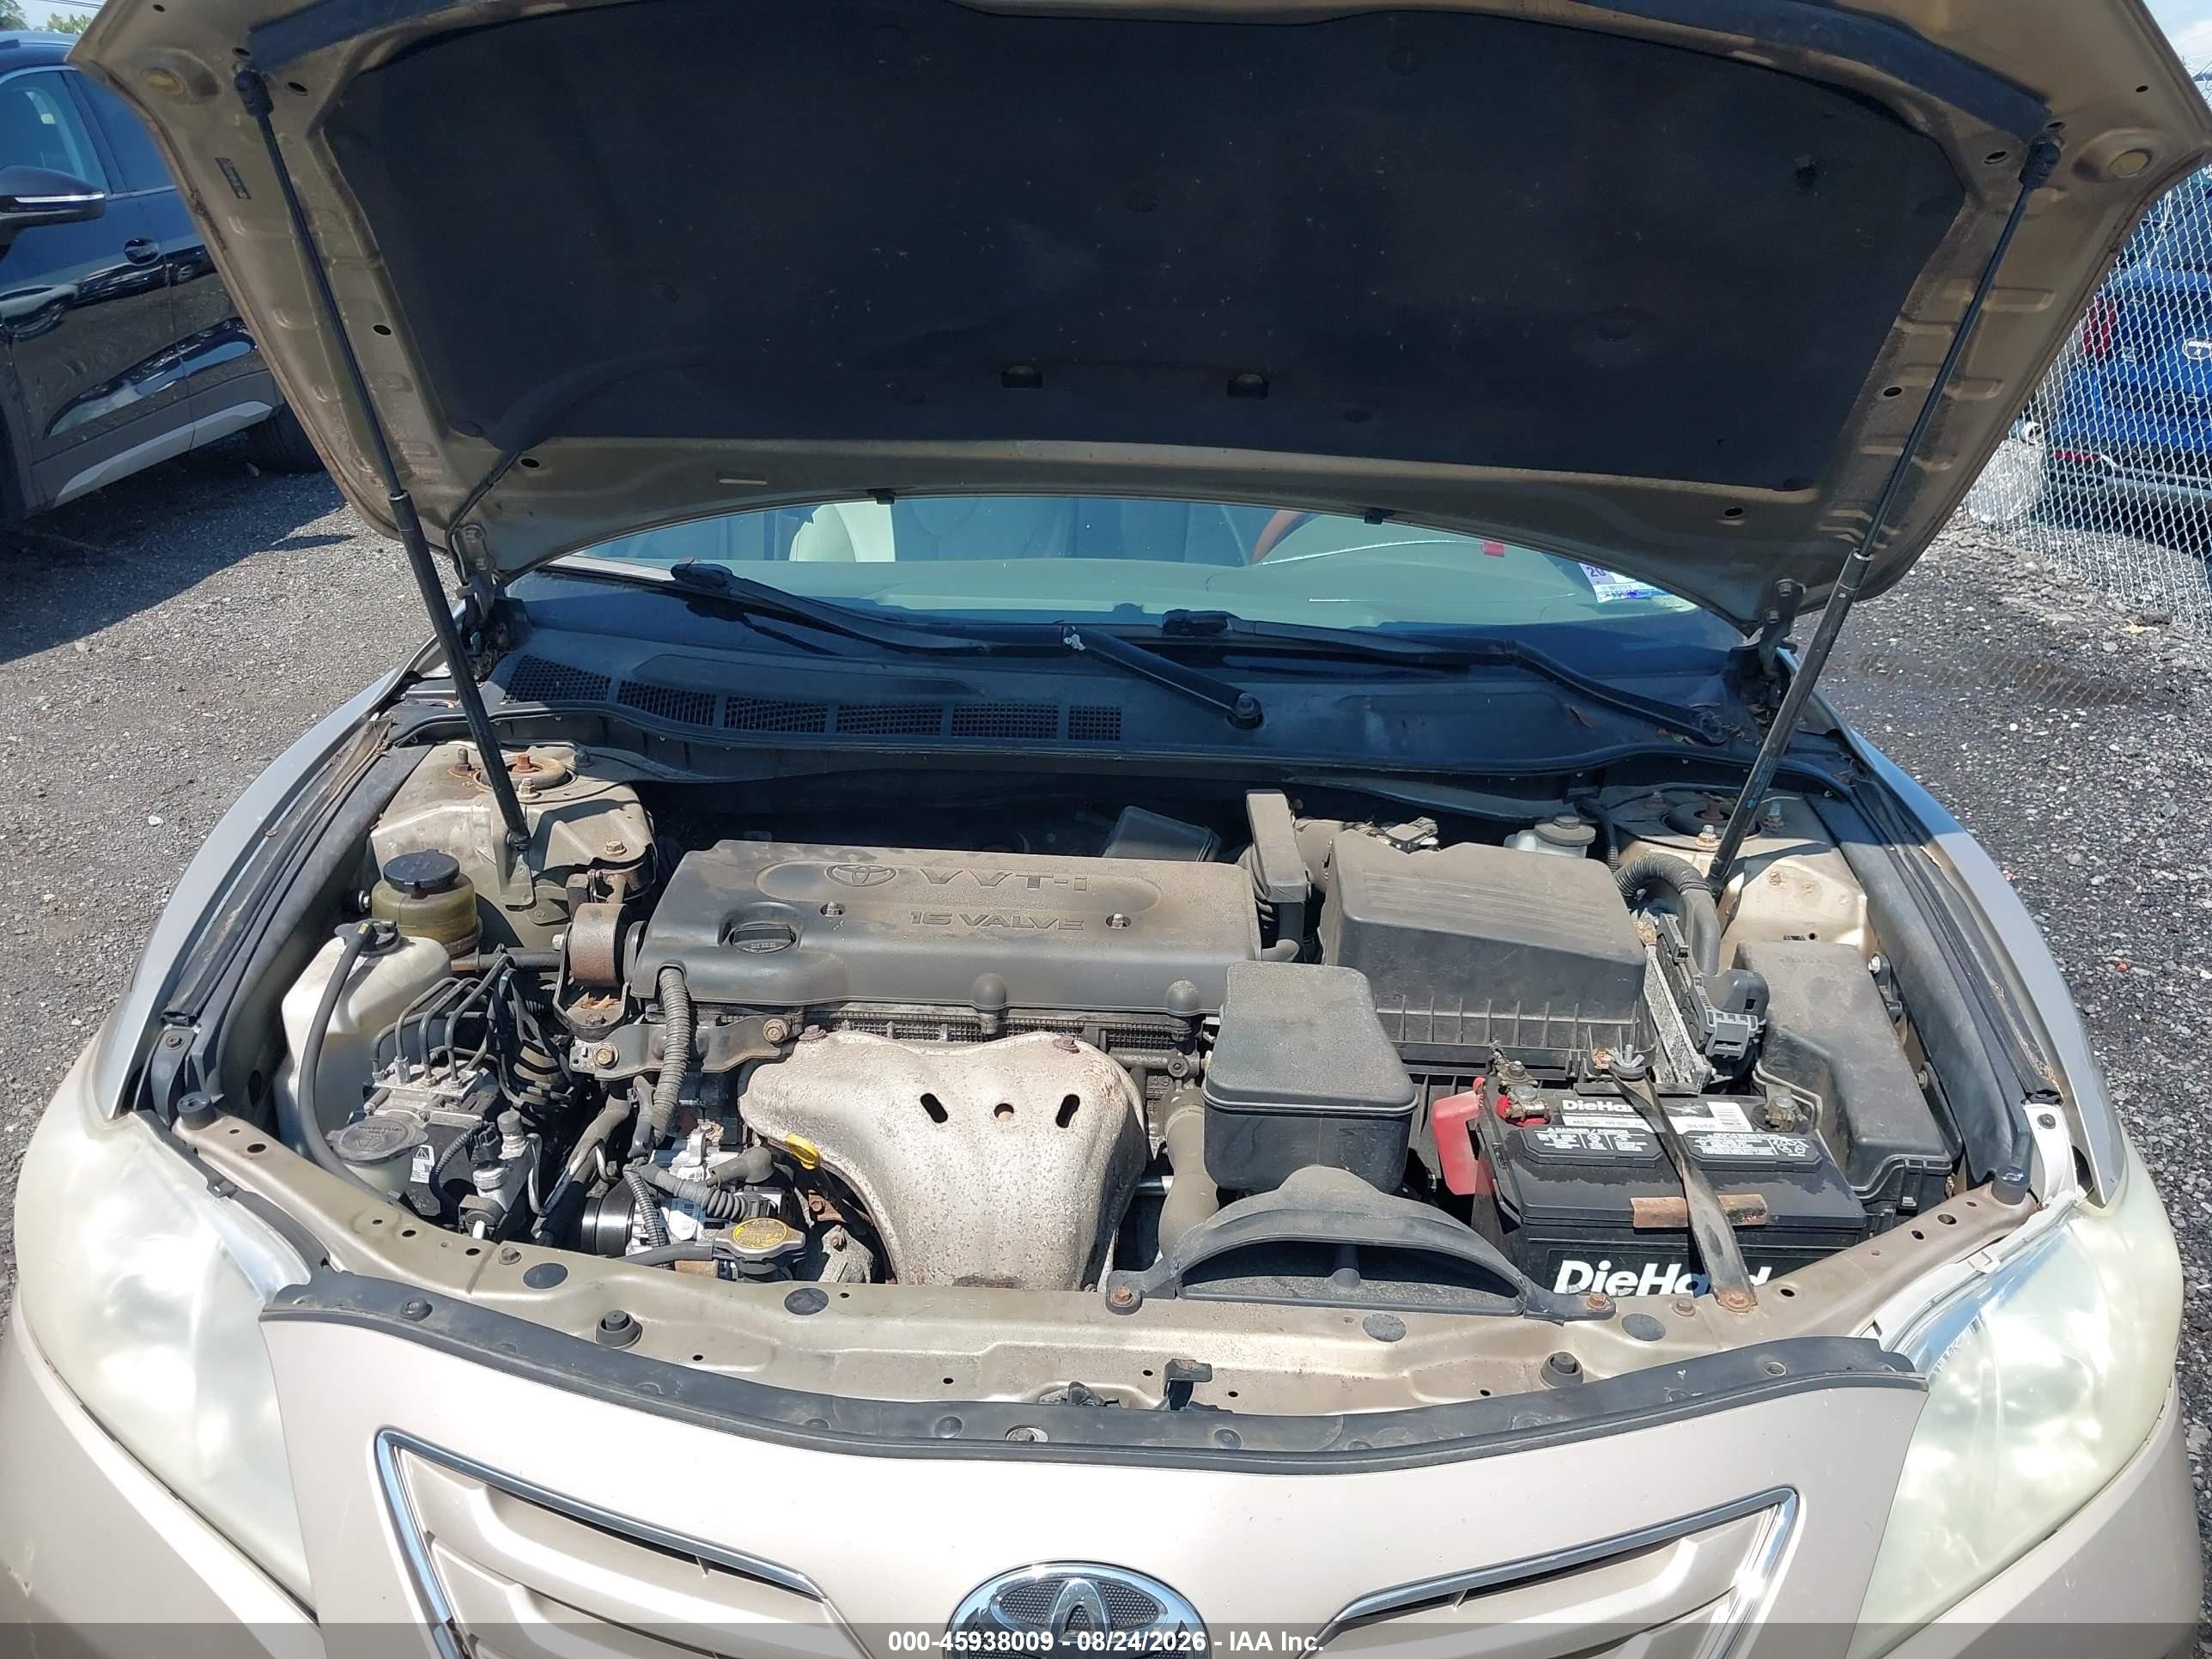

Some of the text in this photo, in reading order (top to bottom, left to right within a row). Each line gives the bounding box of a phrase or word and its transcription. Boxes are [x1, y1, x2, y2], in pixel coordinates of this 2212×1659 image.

[920, 868, 1088, 890] VVT-i
[911, 911, 1085, 931] 16 VALVE
[1553, 1260, 1773, 1298] DieHad
